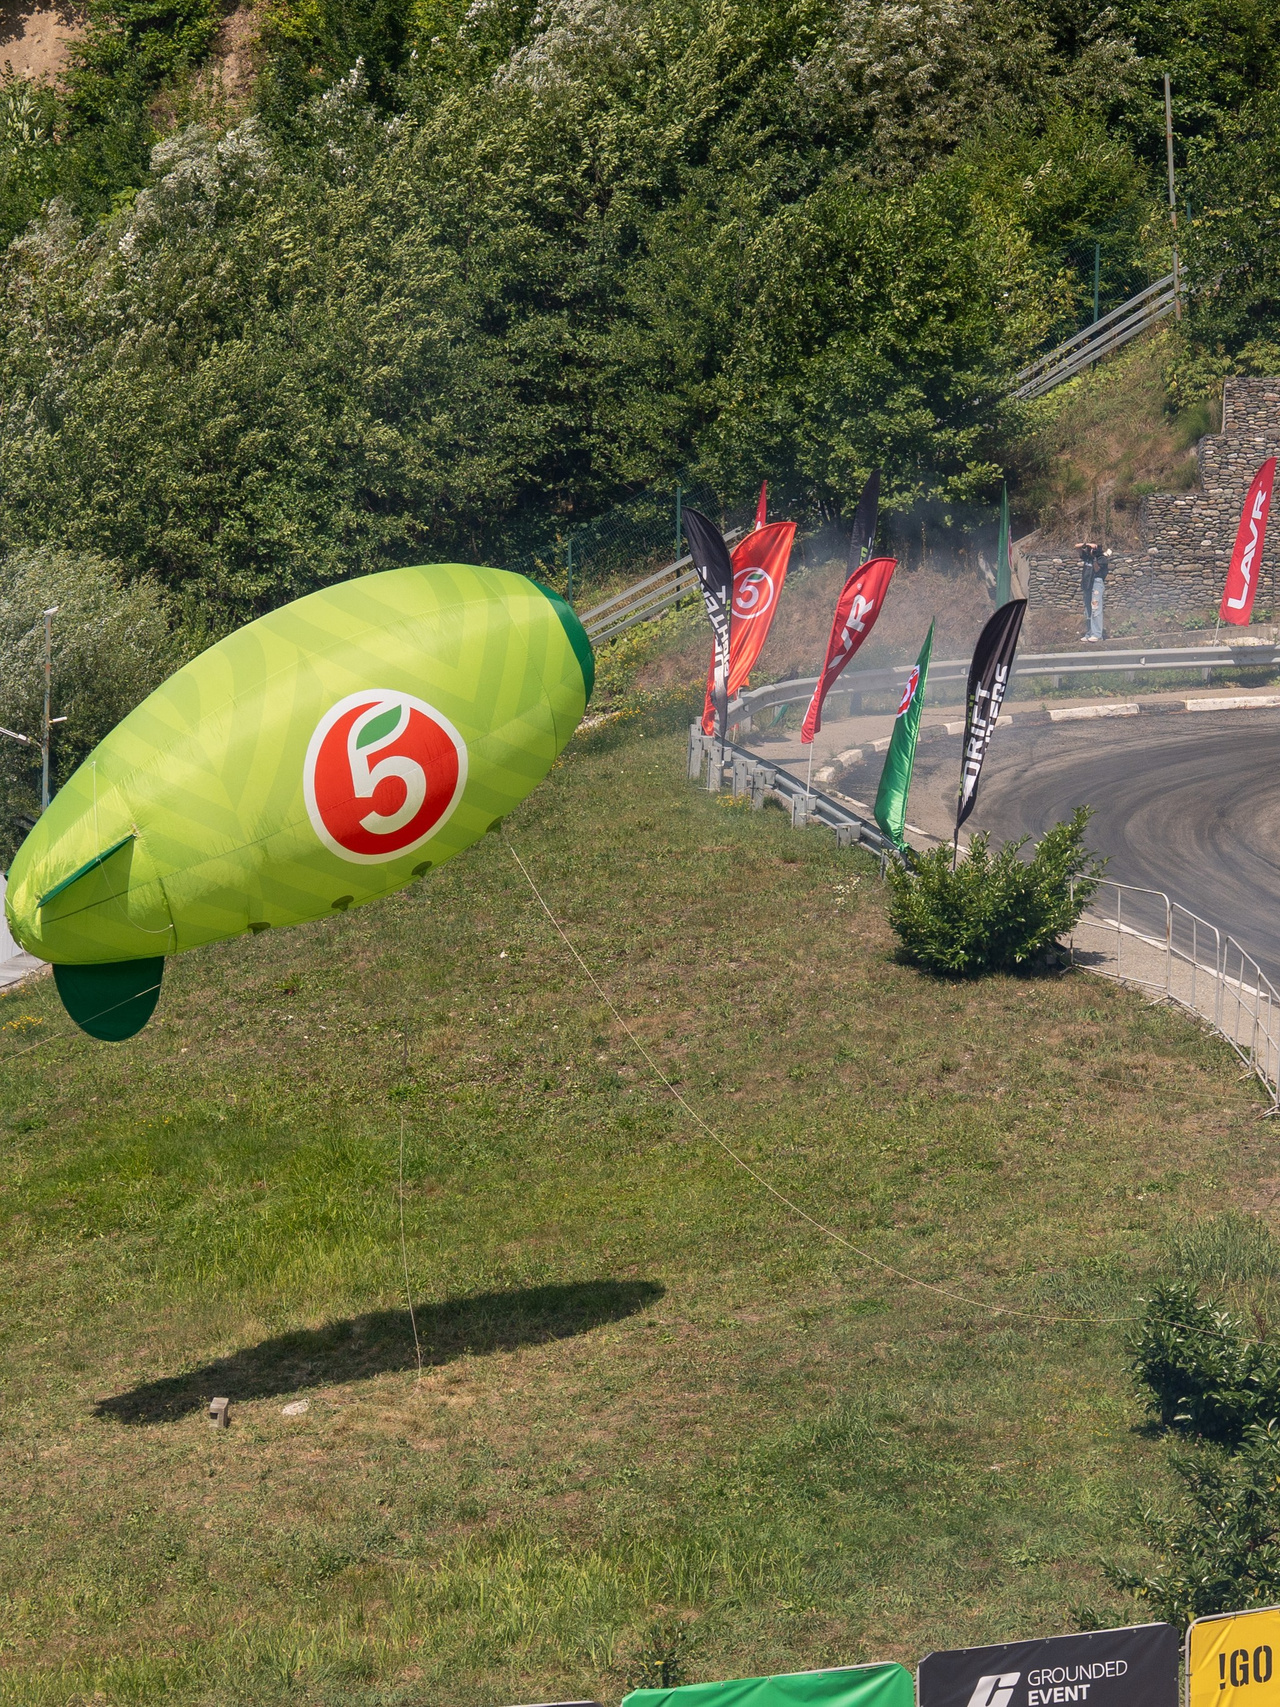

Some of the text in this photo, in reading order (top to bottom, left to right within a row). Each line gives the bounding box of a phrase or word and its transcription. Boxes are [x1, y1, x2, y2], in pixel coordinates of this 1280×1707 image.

[1227, 490, 1267, 609] LAVR
[736, 572, 765, 608] 5
[962, 681, 990, 806] DRIFT
[347, 701, 427, 835] 5
[1027, 1660, 1128, 1686] GROUNDED
[1219, 1645, 1273, 1690] !GO
[1028, 1684, 1091, 1706] EVENT
